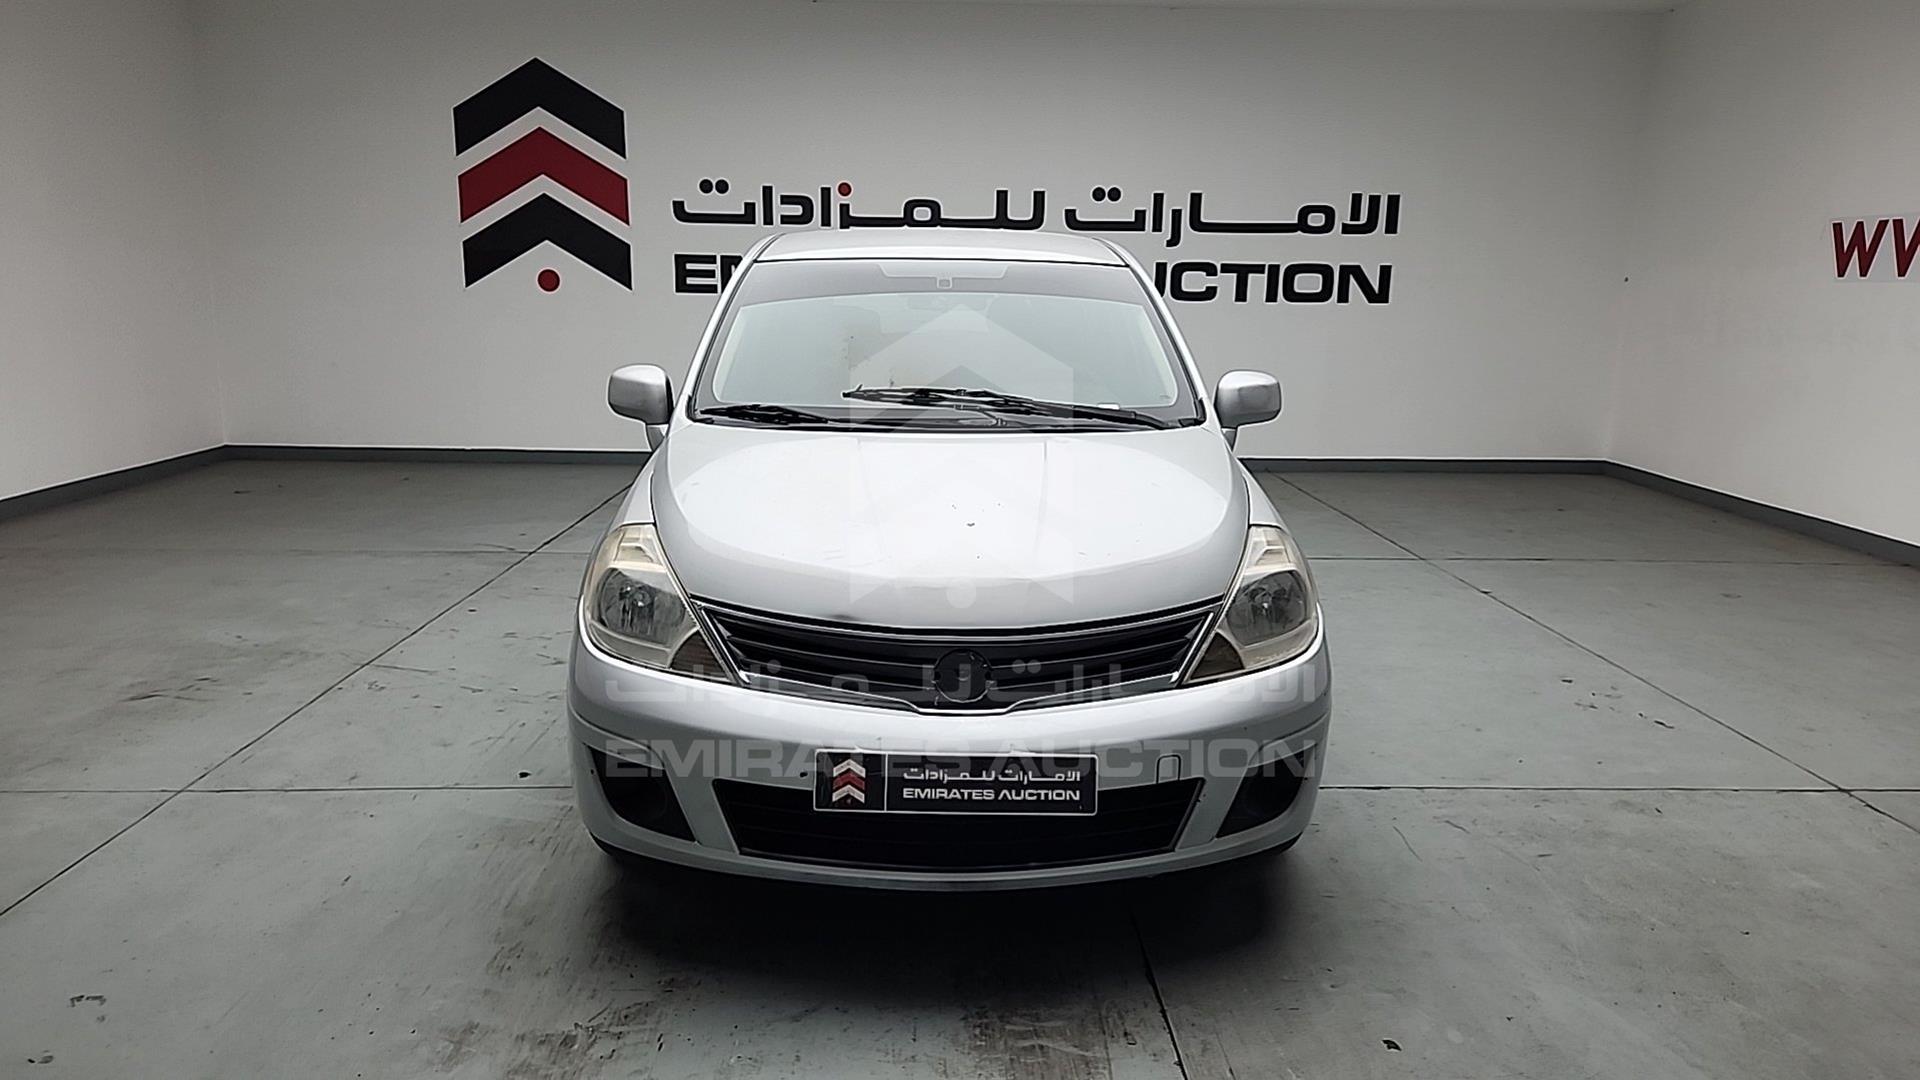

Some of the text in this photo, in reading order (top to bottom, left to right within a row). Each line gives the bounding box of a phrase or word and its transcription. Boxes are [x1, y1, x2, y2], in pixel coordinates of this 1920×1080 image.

[1153, 260, 1393, 305] CTION
[902, 787, 1081, 801] EMIRATES AUCTION
